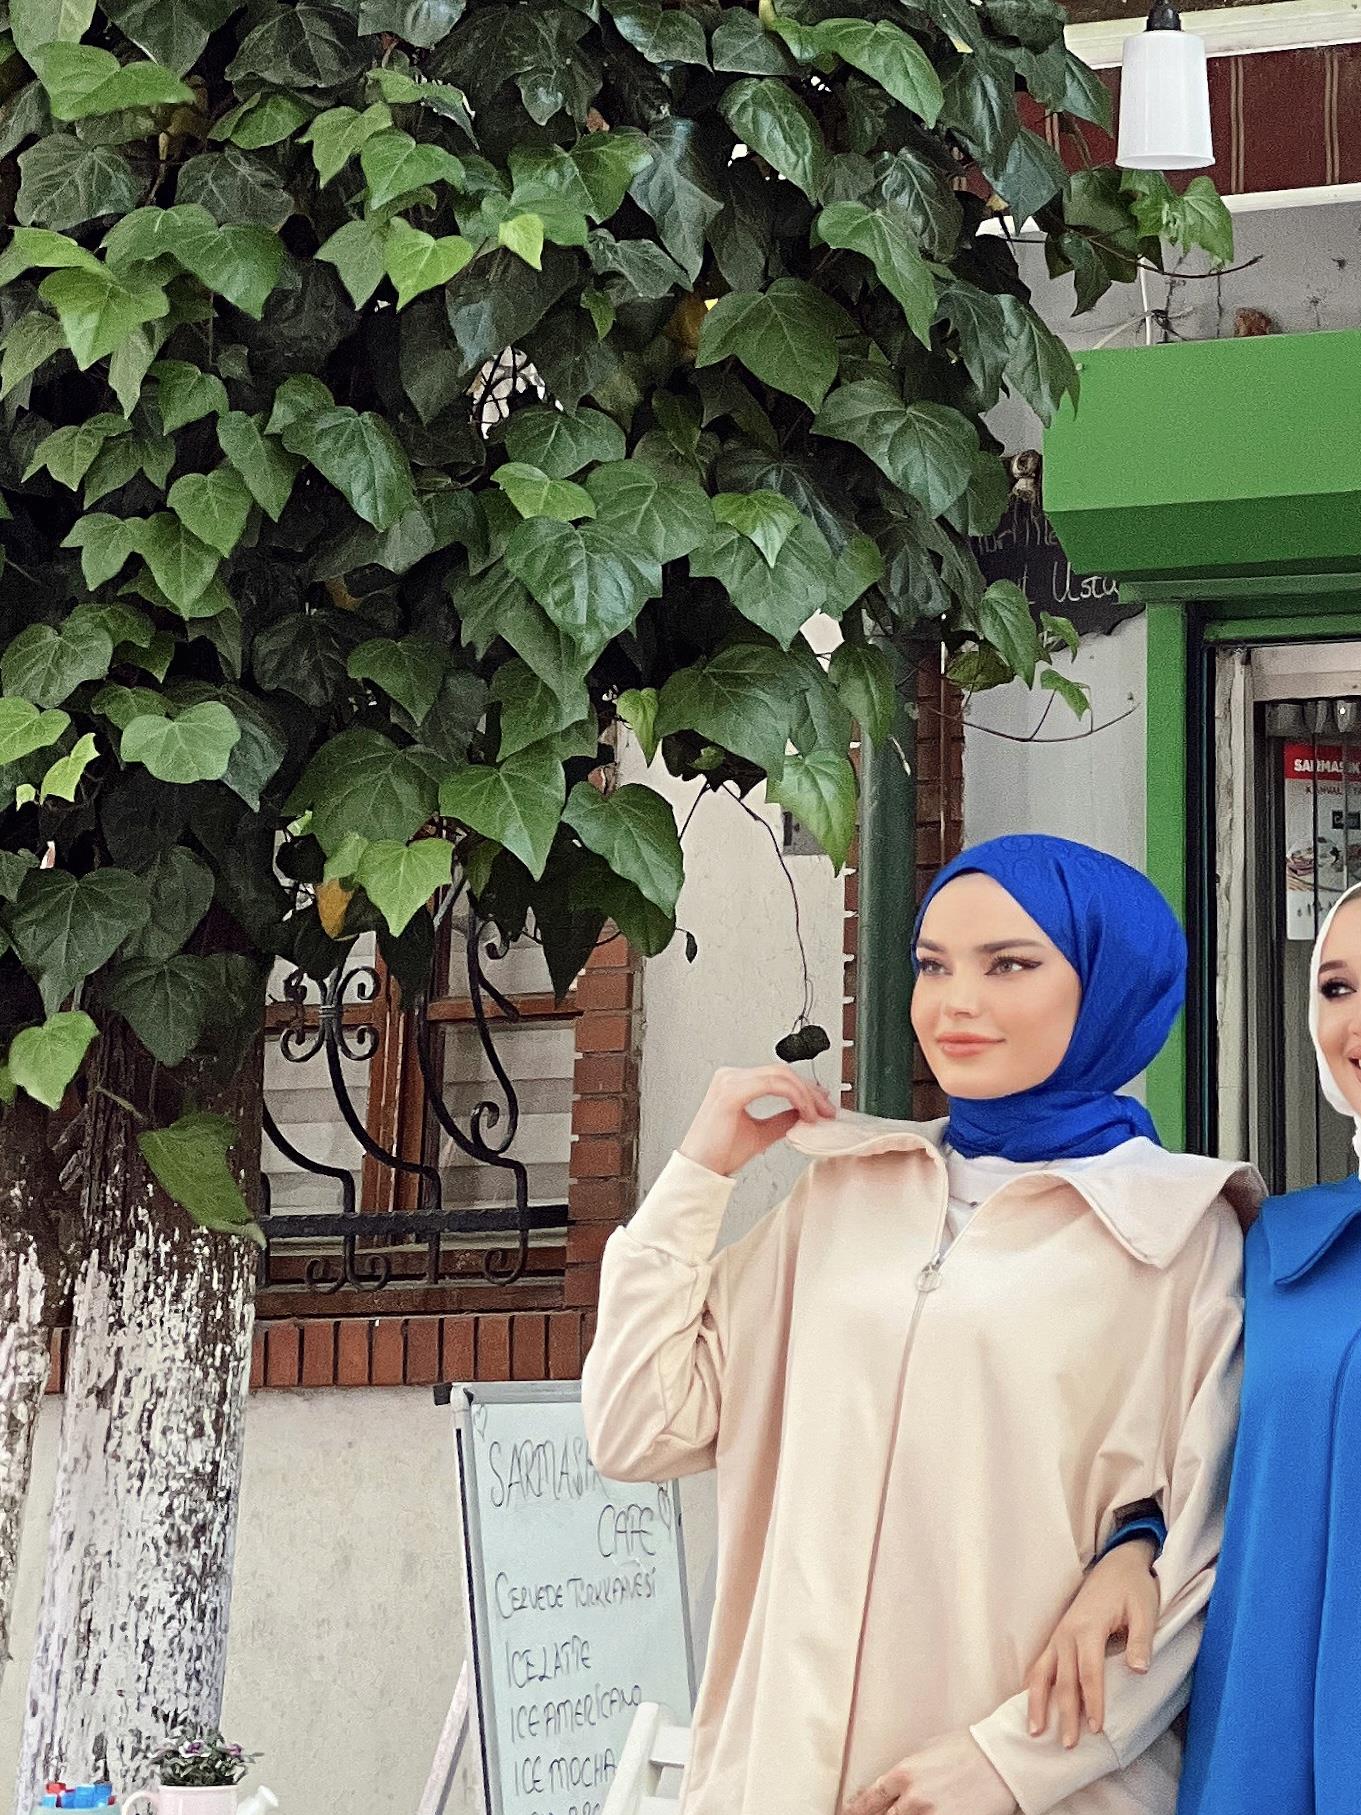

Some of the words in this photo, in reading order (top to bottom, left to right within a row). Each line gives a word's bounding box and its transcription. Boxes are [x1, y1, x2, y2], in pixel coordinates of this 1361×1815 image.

[597, 1503, 657, 1558] CAFE
[514, 1755, 545, 1797] ICE
[549, 1747, 618, 1793] MOCHA
